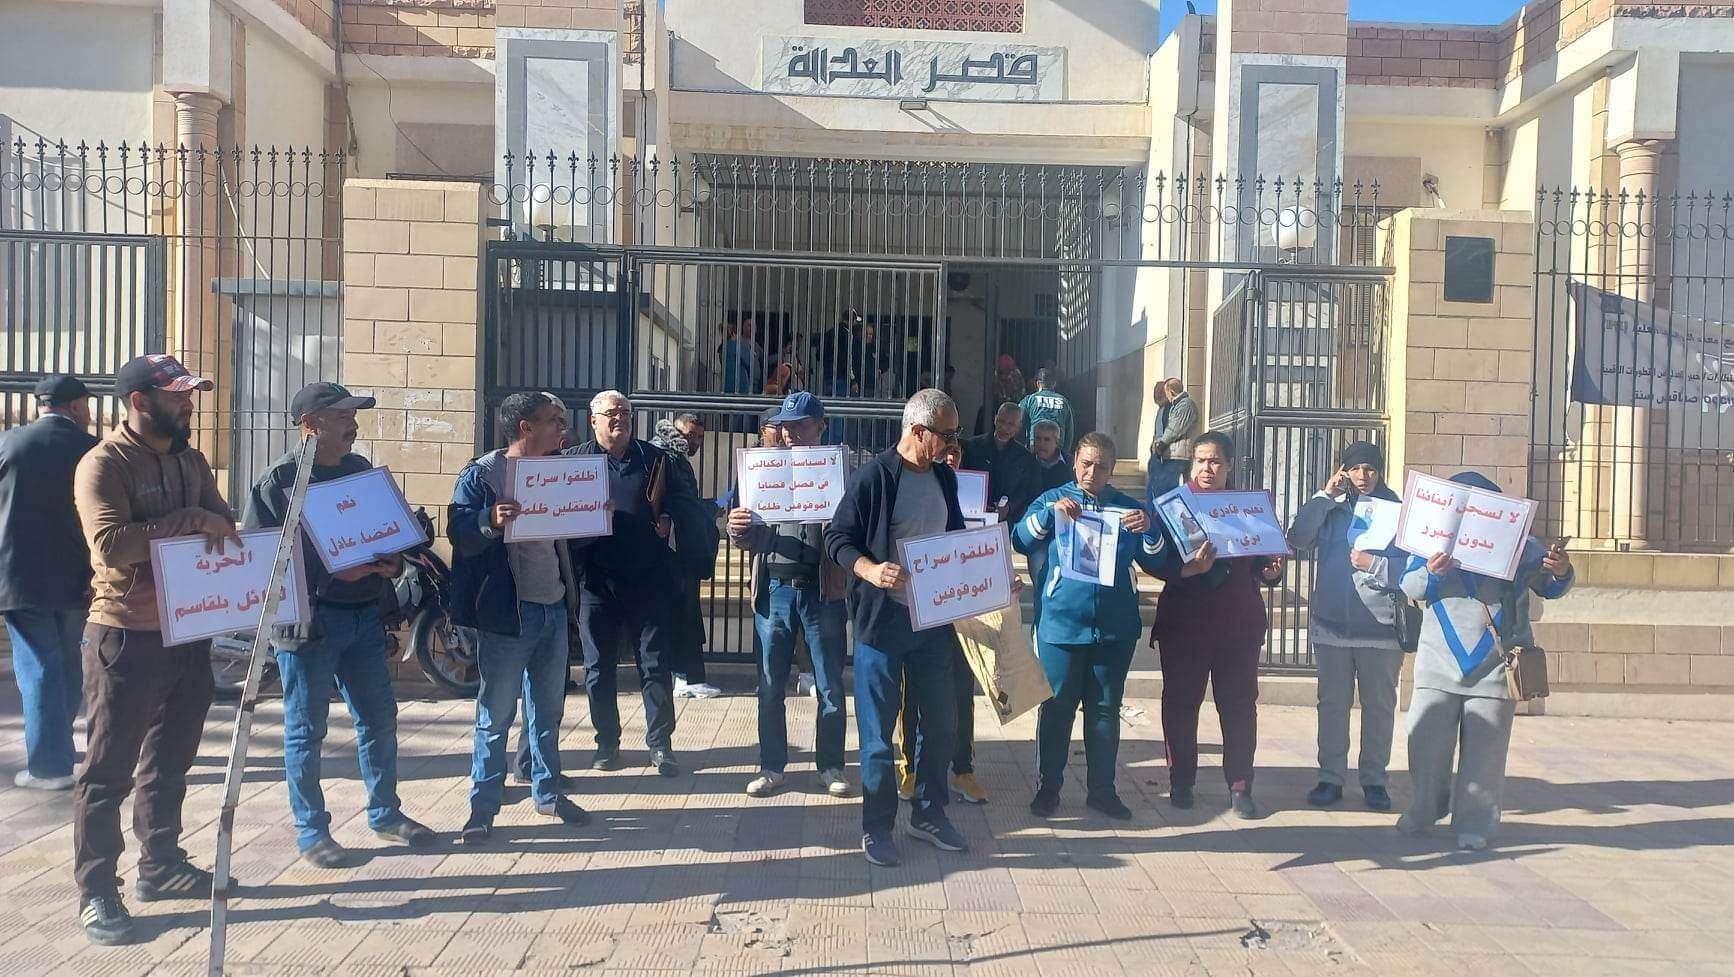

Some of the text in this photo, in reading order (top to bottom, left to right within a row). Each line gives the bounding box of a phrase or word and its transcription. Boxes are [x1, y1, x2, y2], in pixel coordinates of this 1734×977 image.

[788, 45, 1038, 93] قصر العدالة
[526, 466, 598, 488] أطلقوا سراح
[758, 479, 829, 492] في فصل قضايا
[336, 495, 356, 515] نعم
[552, 499, 601, 518] المعتقلين
[784, 500, 830, 513] الموقوفين
[1455, 501, 1503, 520] لسجن
[1508, 511, 1521, 524] لا
[329, 536, 356, 557] عادل
[1458, 533, 1494, 554] بدون
[196, 549, 253, 575] الحرية
[913, 537, 1000, 574] أطلقوا سراح
[933, 576, 993, 607] الموقوفين
[175, 593, 229, 623] بلقاسم
